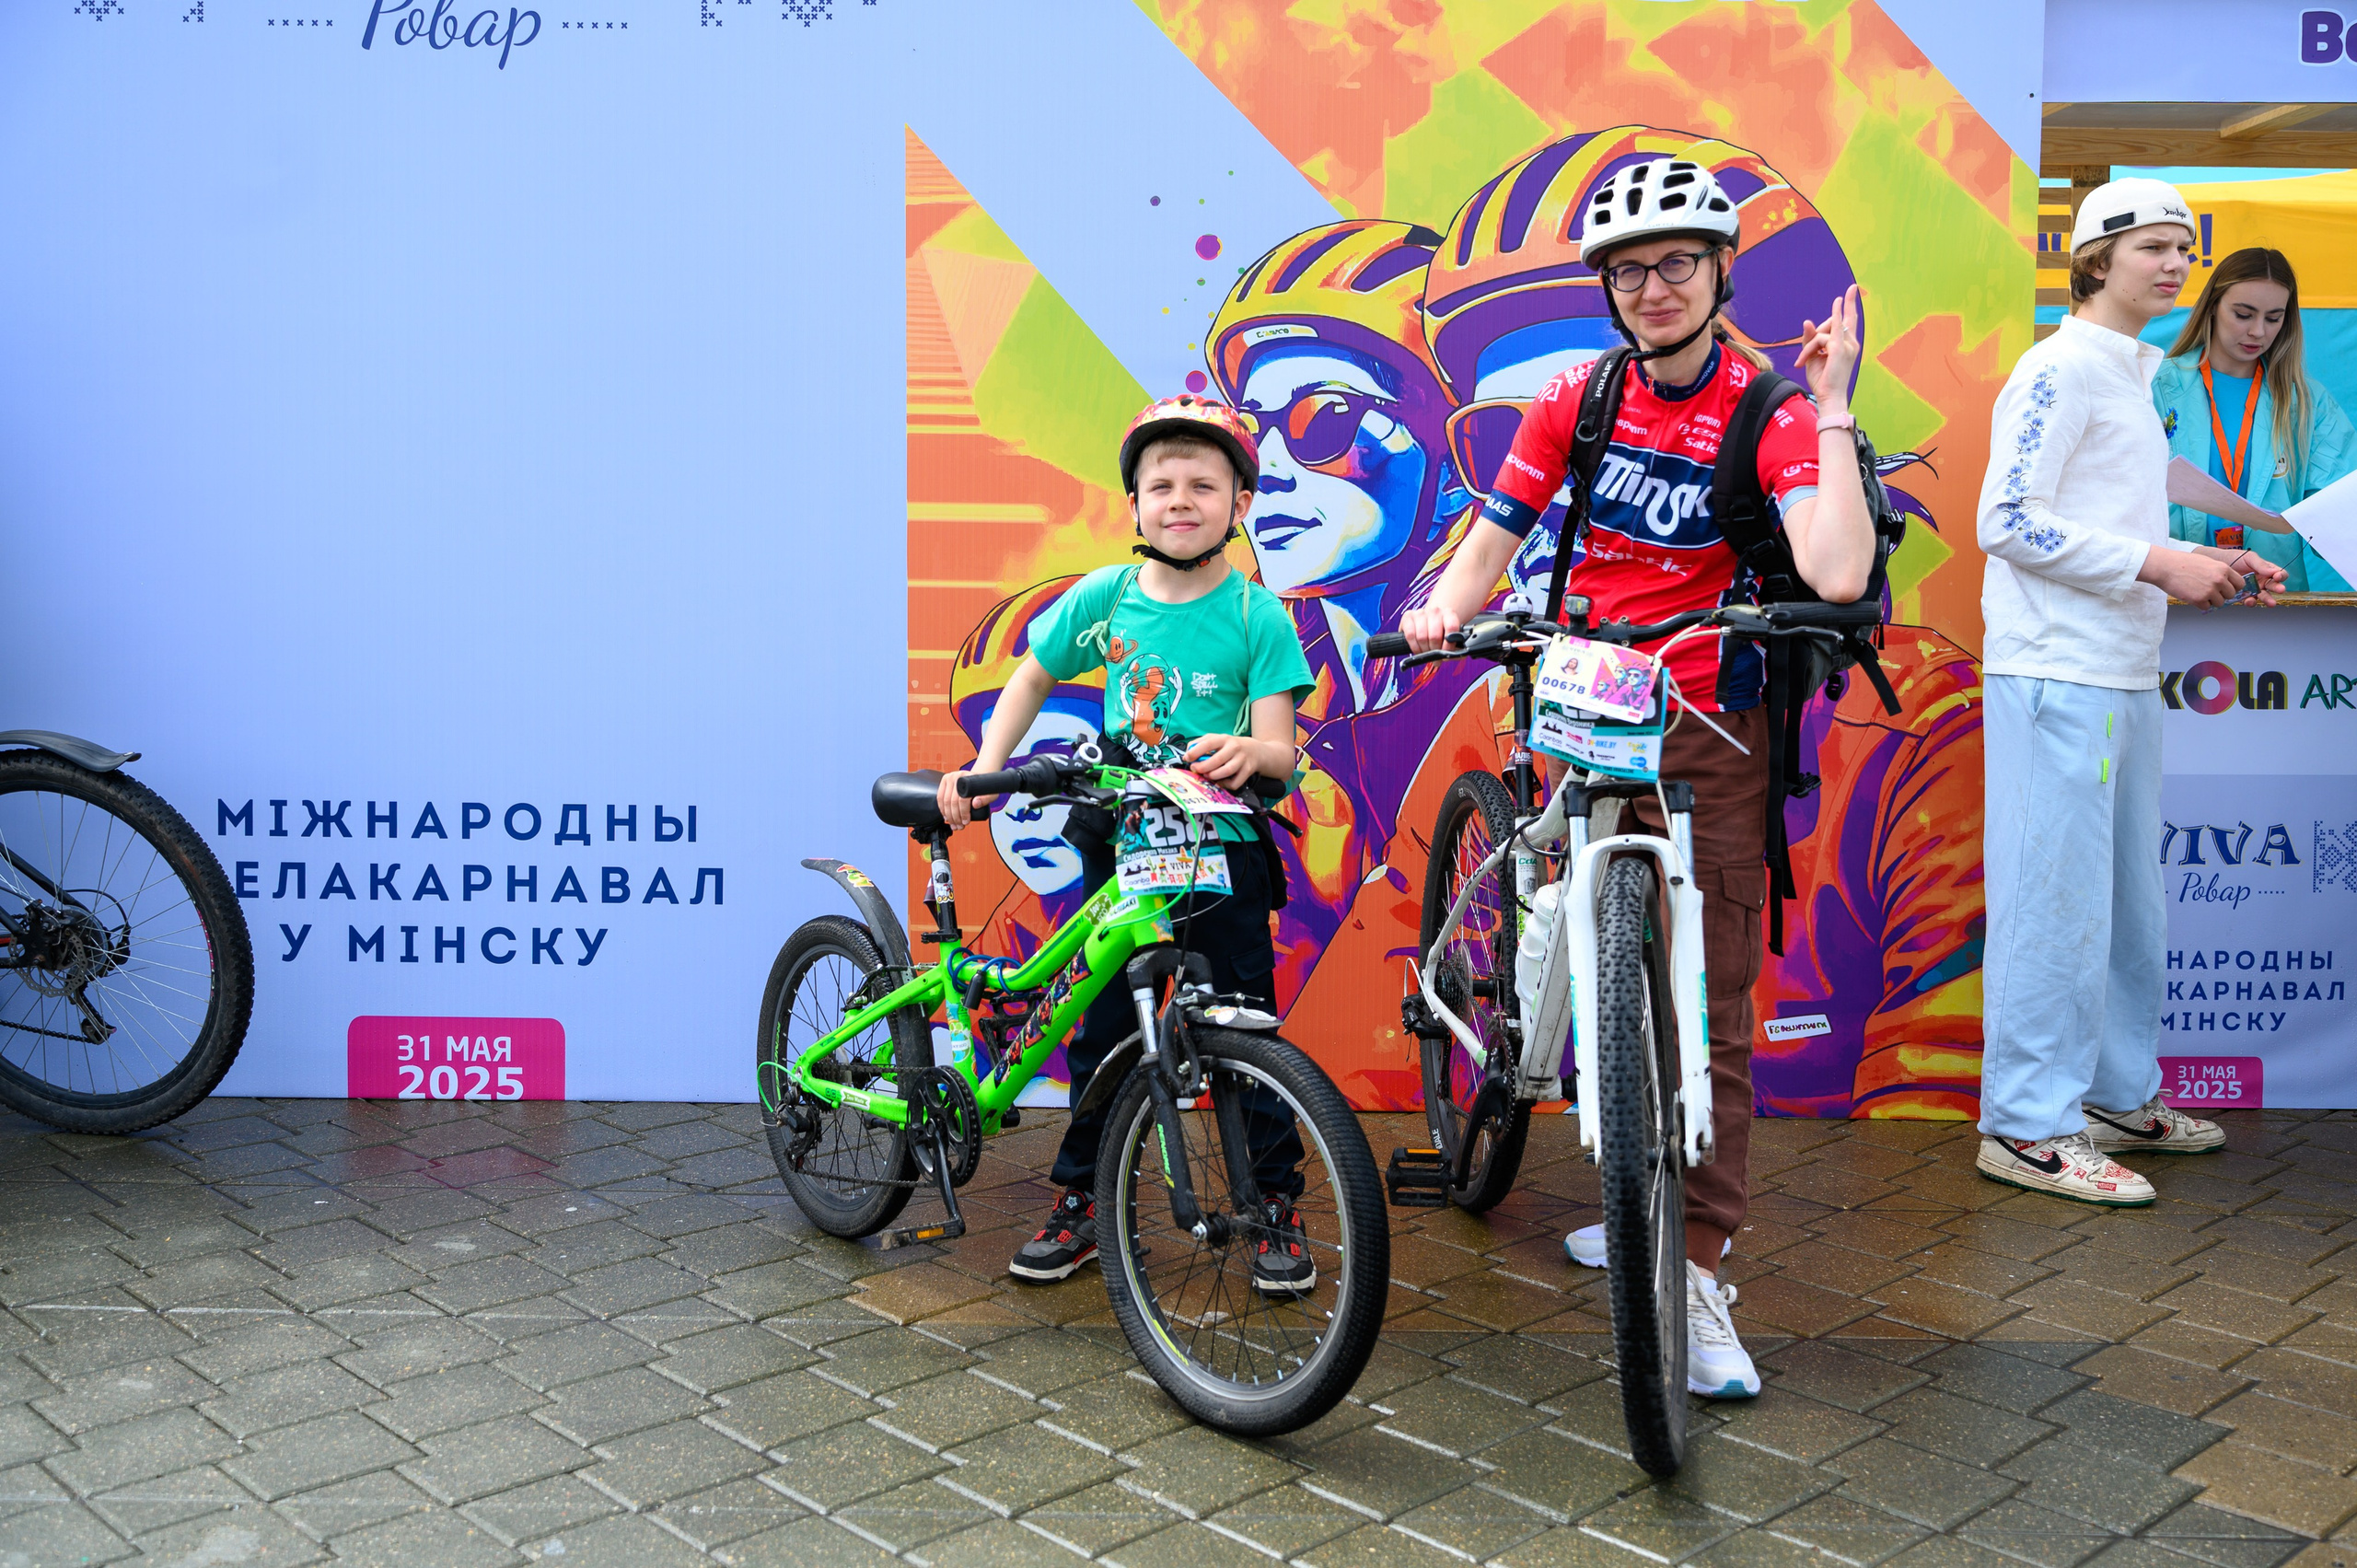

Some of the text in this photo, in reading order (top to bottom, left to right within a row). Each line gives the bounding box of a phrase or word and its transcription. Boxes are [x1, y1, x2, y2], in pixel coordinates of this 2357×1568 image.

[362, 0, 541, 70] Ровар
[1595, 362, 1613, 398] POLAR
[1541, 676, 1586, 695] 00678
[2299, 673, 2357, 711] AR
[217, 797, 697, 846] МІЖНАРОДНЫ
[236, 860, 725, 905] ЕЛАКАРНАВАЛ
[2178, 872, 2251, 911] Ровар
[279, 923, 609, 967] У МІНСКУ
[2166, 950, 2333, 972] НАРОДНЫ
[2167, 981, 2345, 1001] КАРНАВАЛ
[397, 1034, 512, 1063] 31 МАЯ
[398, 1063, 524, 1100] 2025
[2177, 1065, 2236, 1079] 31 МАЯ
[2177, 1080, 2243, 1099] 2025
